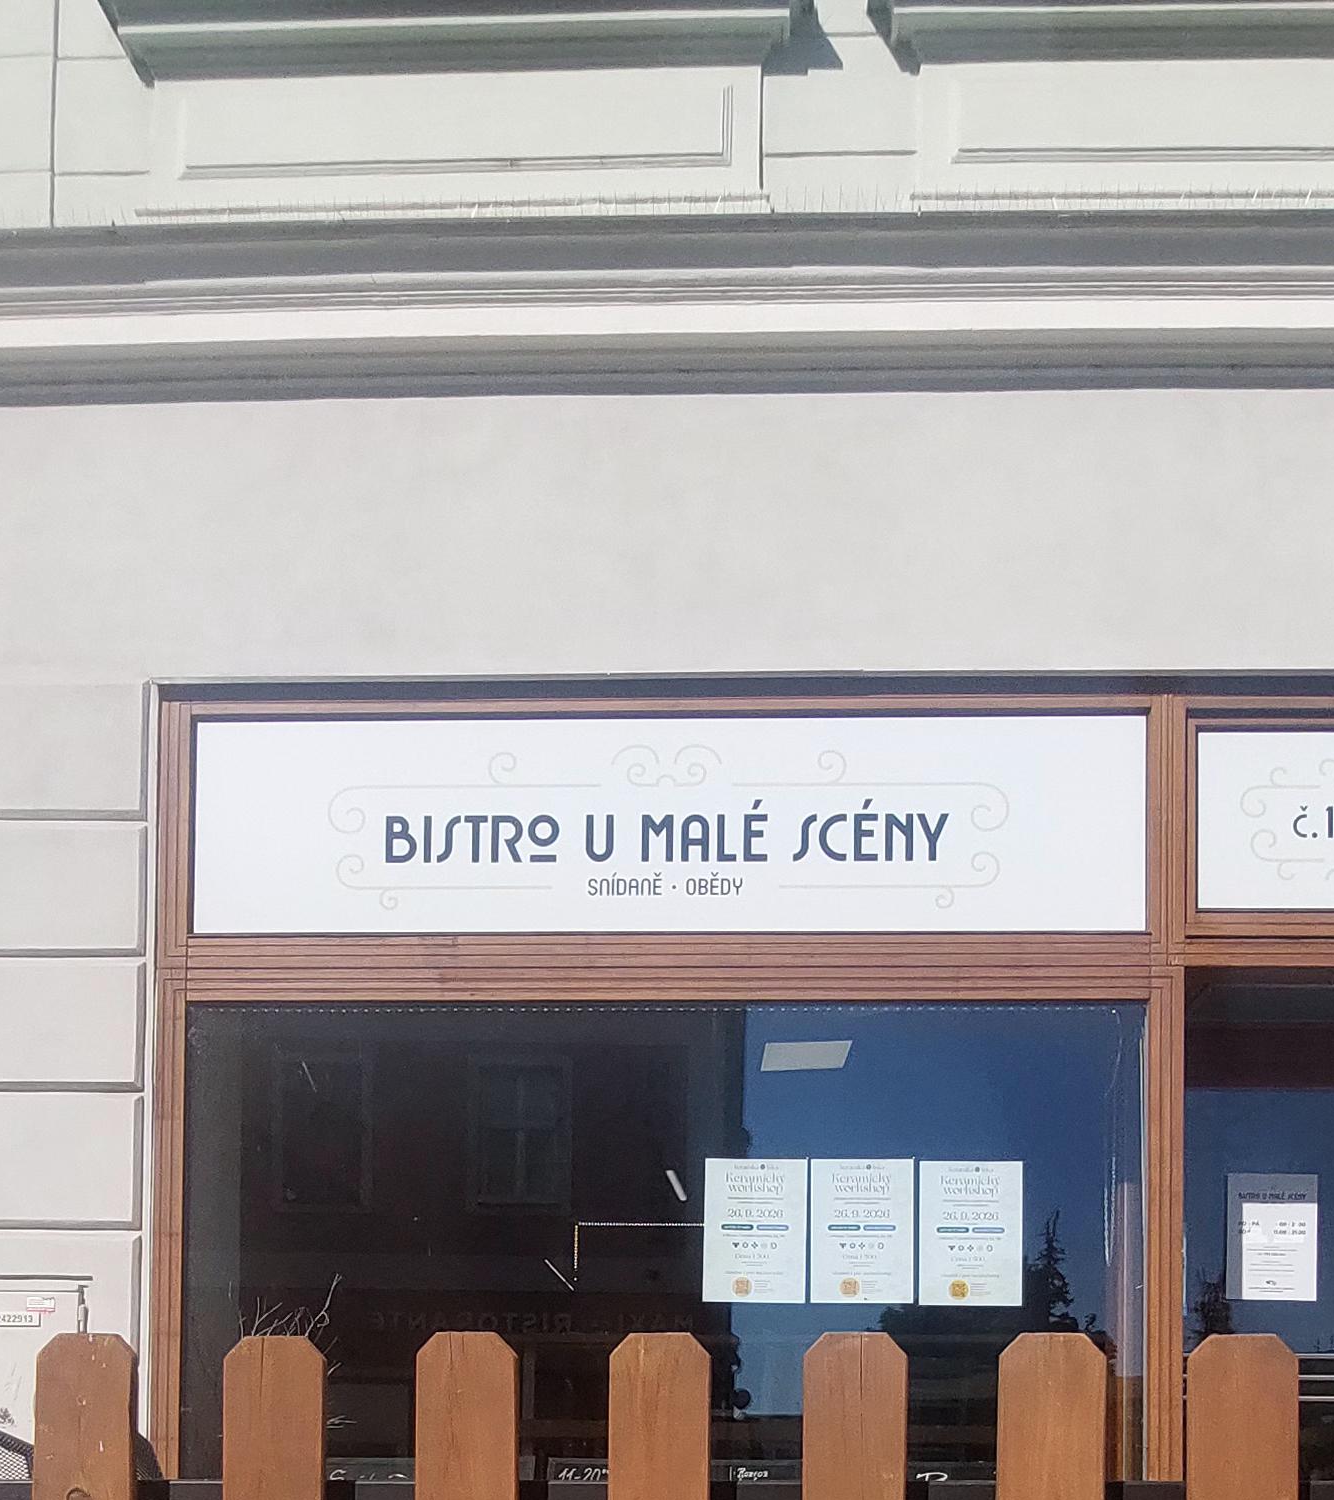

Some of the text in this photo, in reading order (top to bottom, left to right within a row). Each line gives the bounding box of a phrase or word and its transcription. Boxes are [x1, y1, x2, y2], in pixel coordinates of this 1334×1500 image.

[385, 798, 949, 864] BISTRO U MALÉ SCÉNY
[587, 871, 743, 896] SNÍDANĚ OBĚDY
